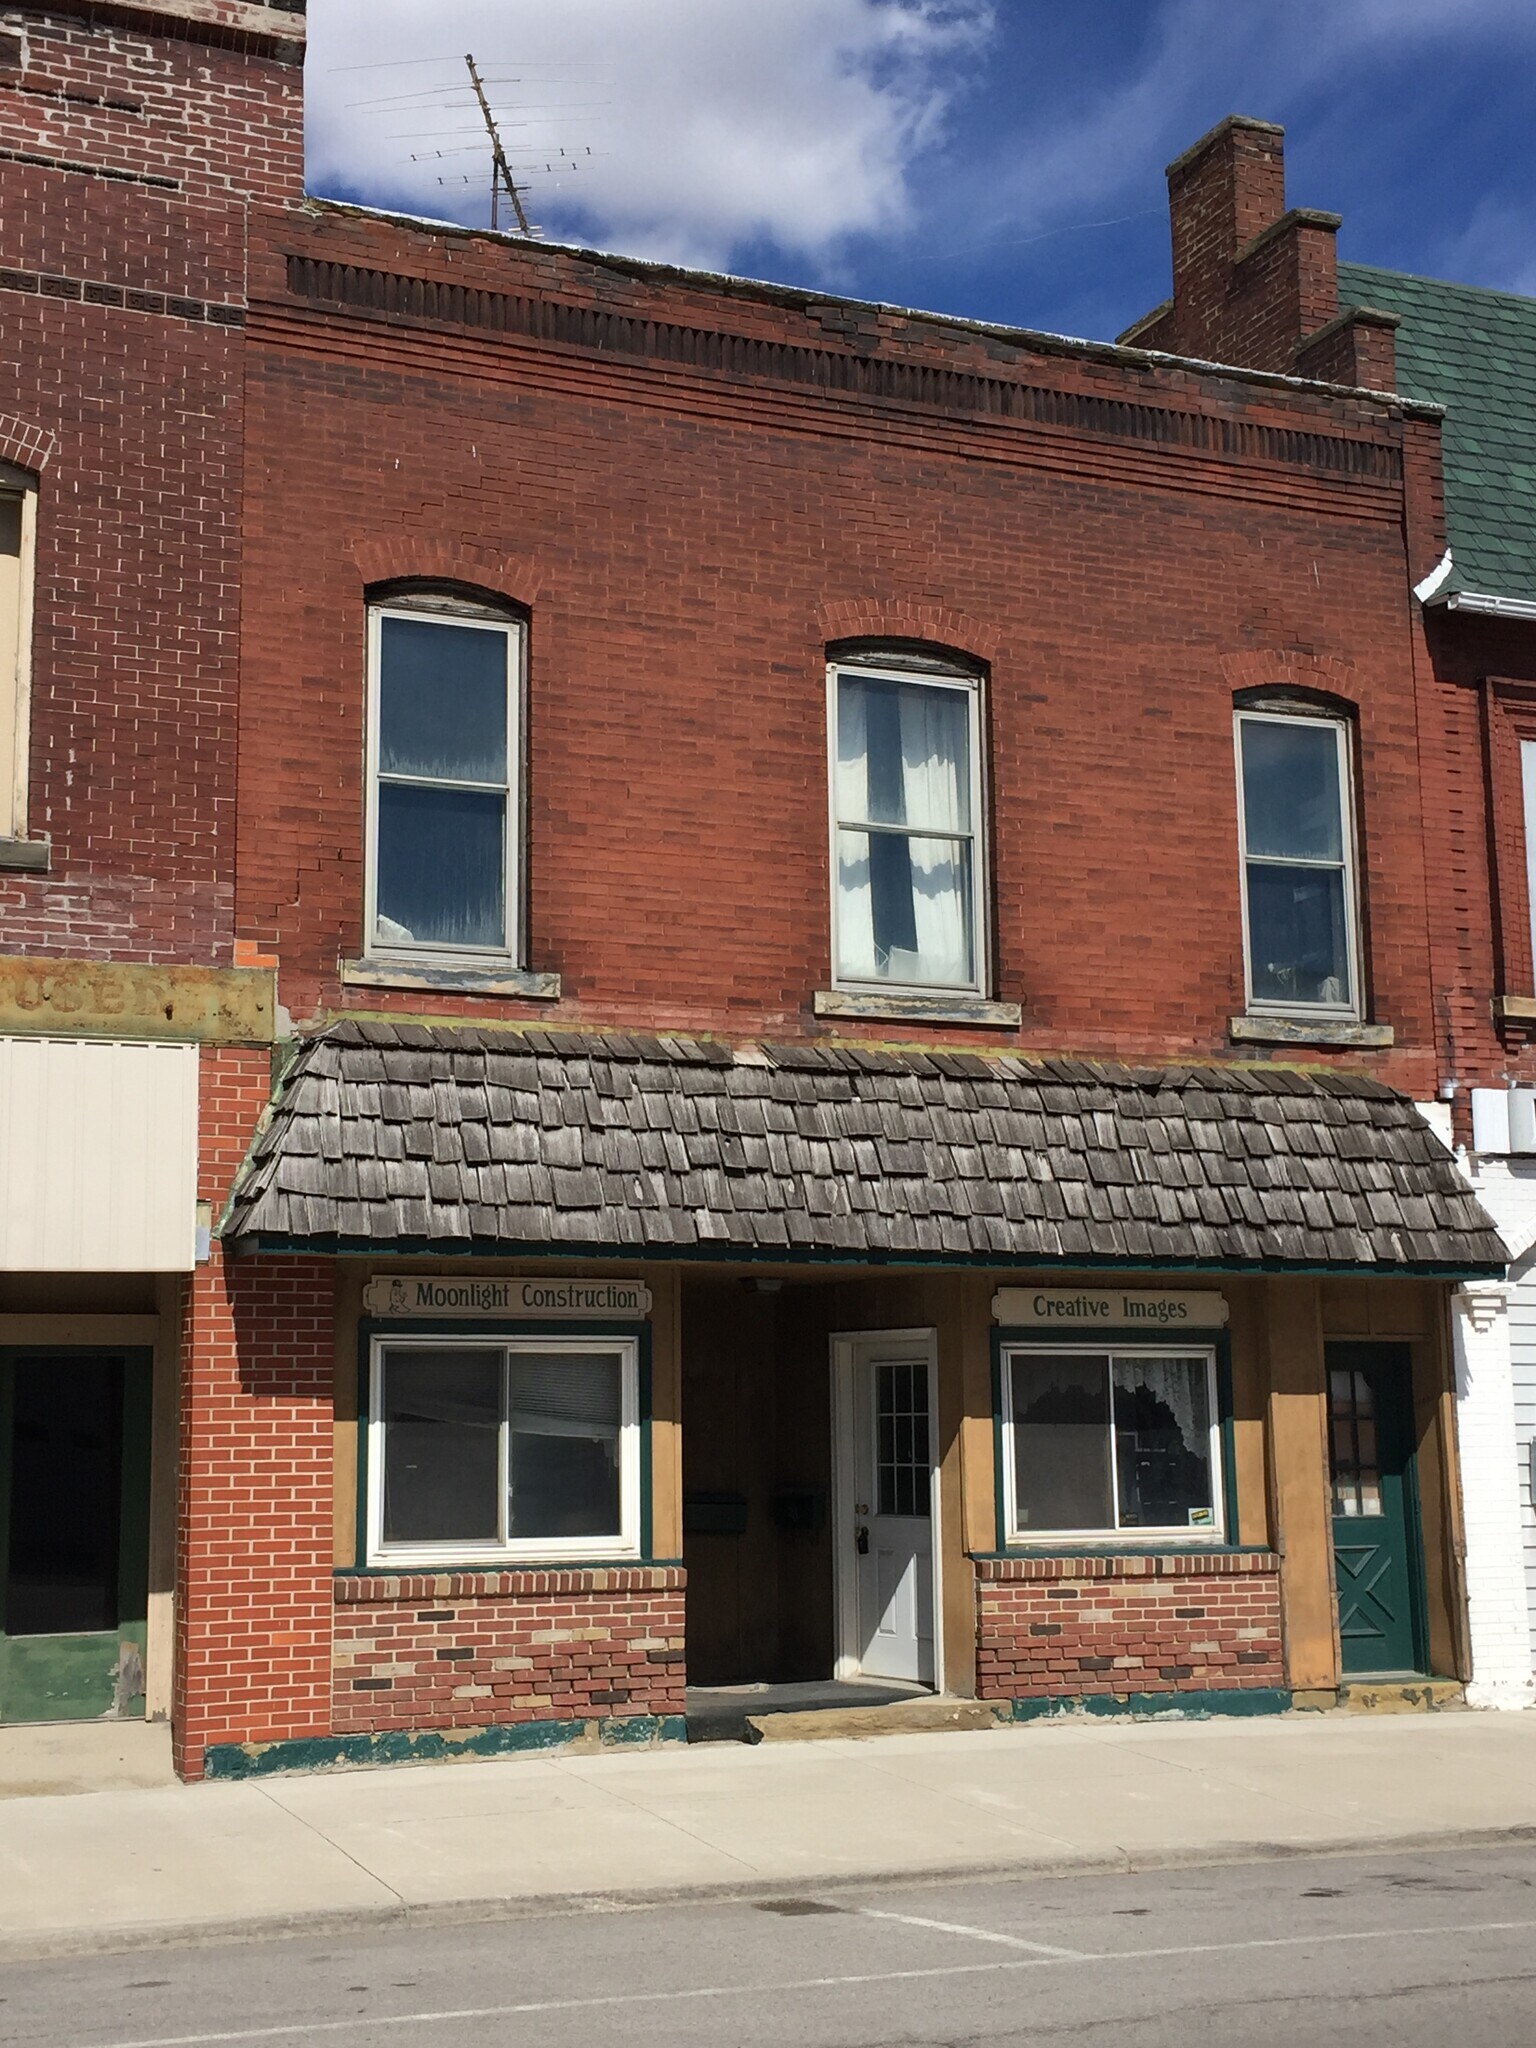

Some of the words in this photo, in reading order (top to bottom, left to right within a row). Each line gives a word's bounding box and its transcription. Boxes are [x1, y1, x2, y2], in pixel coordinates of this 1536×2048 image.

[416, 1282, 510, 1311] Moonlight
[521, 1283, 639, 1309] Construction
[1032, 1294, 1110, 1318] Creative
[1122, 1296, 1188, 1323] Images
